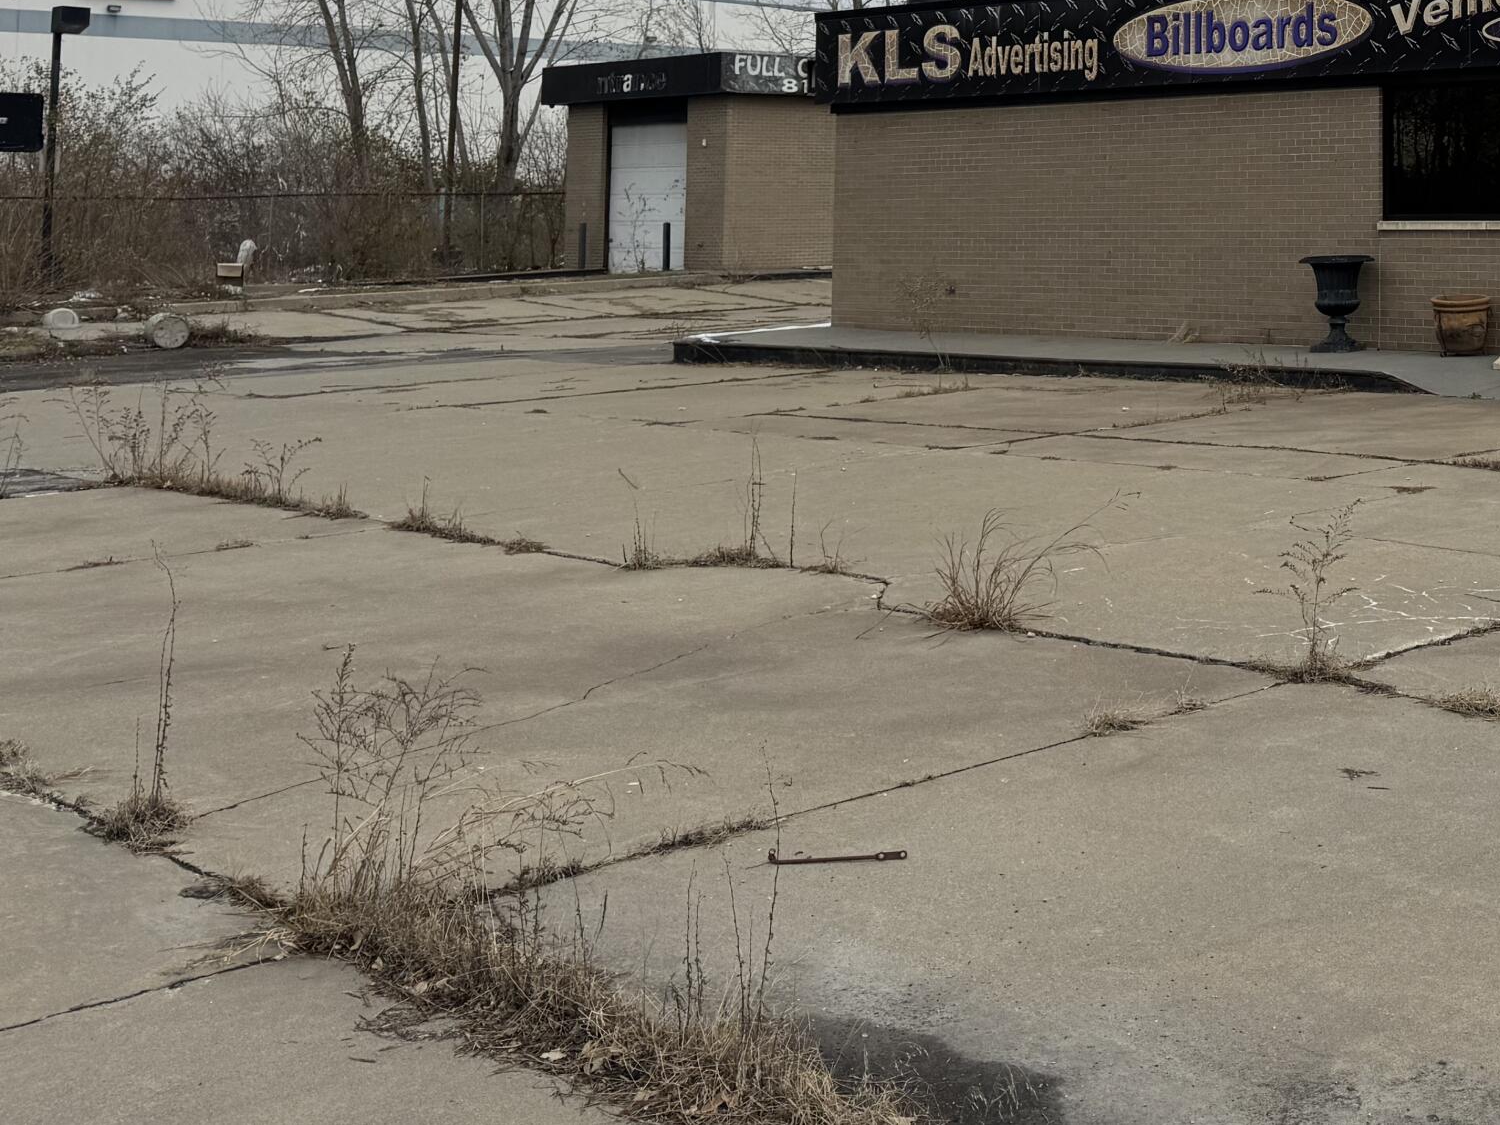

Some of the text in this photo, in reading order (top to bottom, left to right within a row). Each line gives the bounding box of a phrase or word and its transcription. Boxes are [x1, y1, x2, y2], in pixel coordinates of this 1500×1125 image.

[838, 24, 1099, 86] KLS Advertising
[1145, 1, 1339, 58] Billboards
[734, 54, 785, 76] FULL
